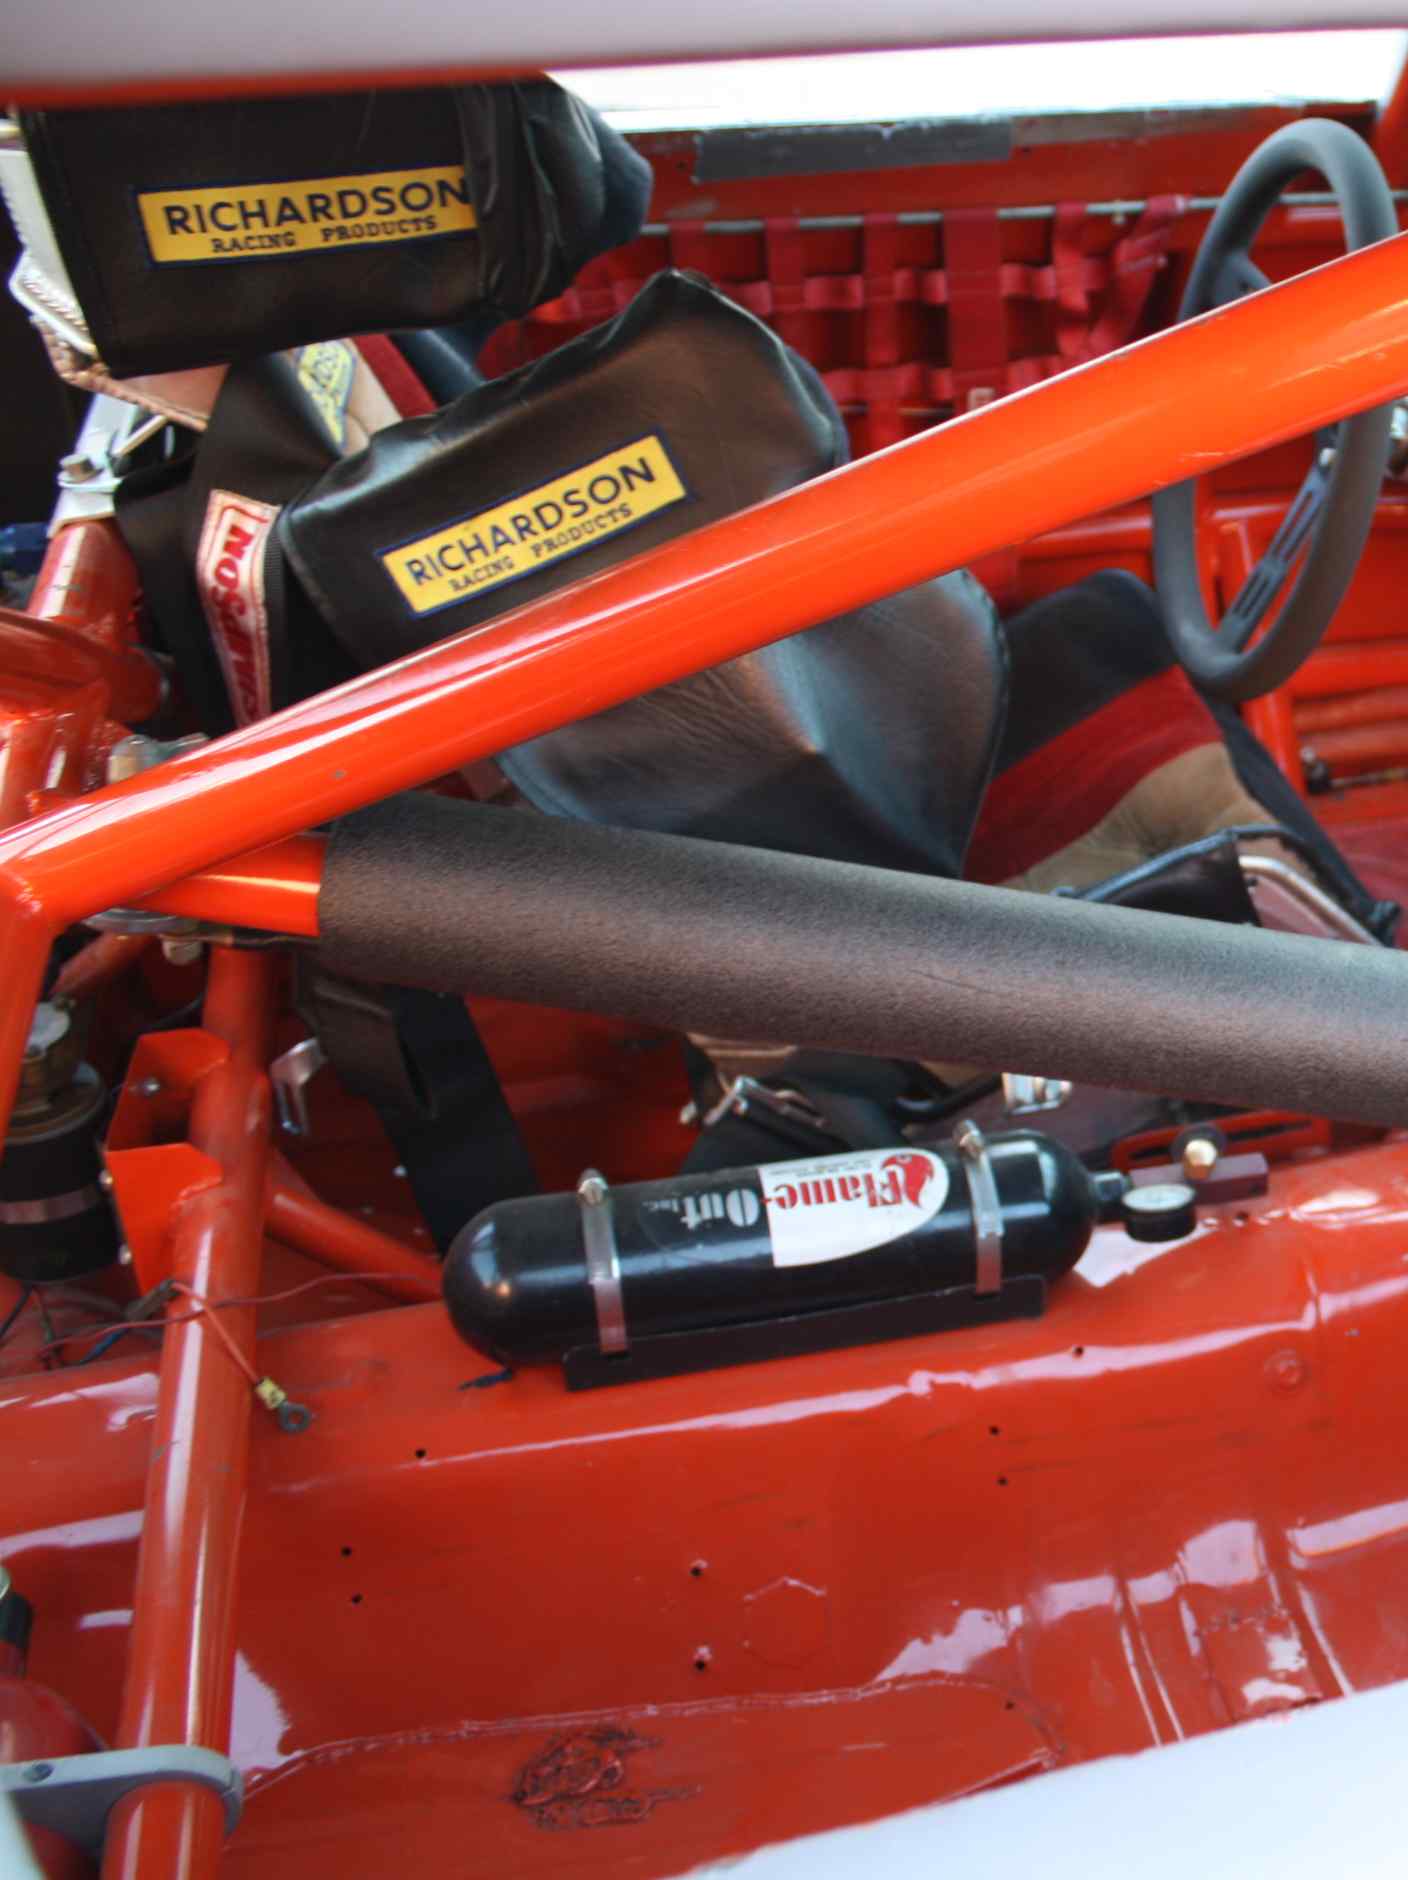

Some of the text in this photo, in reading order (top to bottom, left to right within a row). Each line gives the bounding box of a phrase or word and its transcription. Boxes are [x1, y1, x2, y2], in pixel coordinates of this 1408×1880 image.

[163, 178, 474, 236] RICHARDSON
[212, 215, 438, 254] RACING PRODUCTS
[405, 457, 657, 586] RICHARDSON
[448, 502, 633, 592] RACING PRODUCTS
